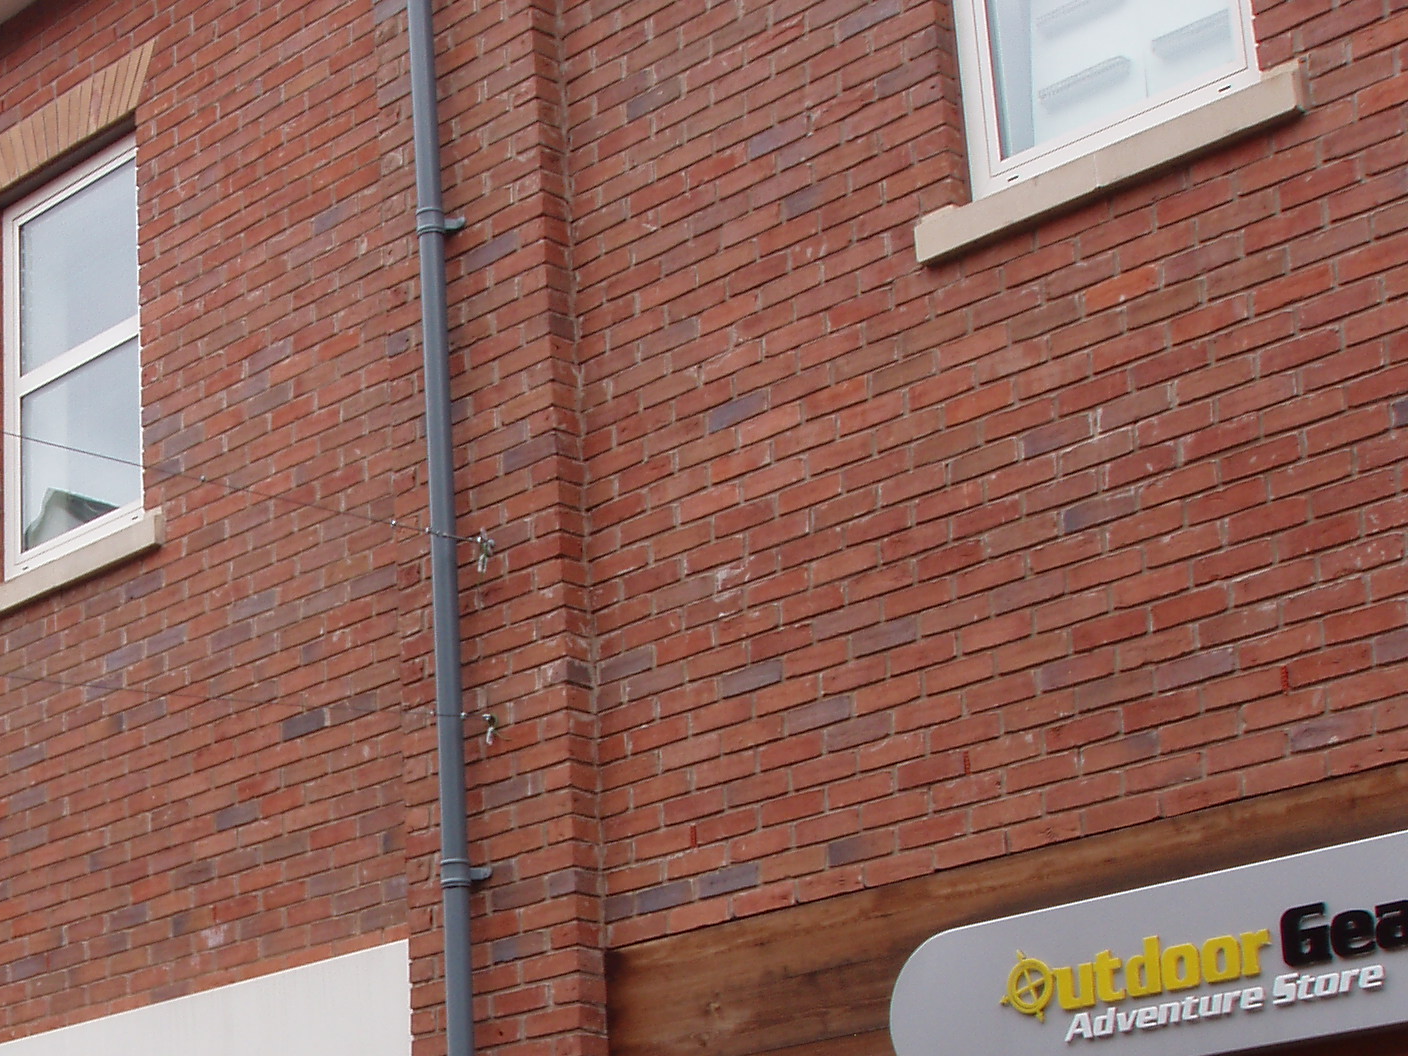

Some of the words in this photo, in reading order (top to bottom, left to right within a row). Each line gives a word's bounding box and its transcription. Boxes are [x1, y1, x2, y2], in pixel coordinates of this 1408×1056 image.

[1001, 929, 1272, 1022] Outdoor
[1064, 985, 1266, 1043] Adventure
[1272, 963, 1385, 1007] Store
